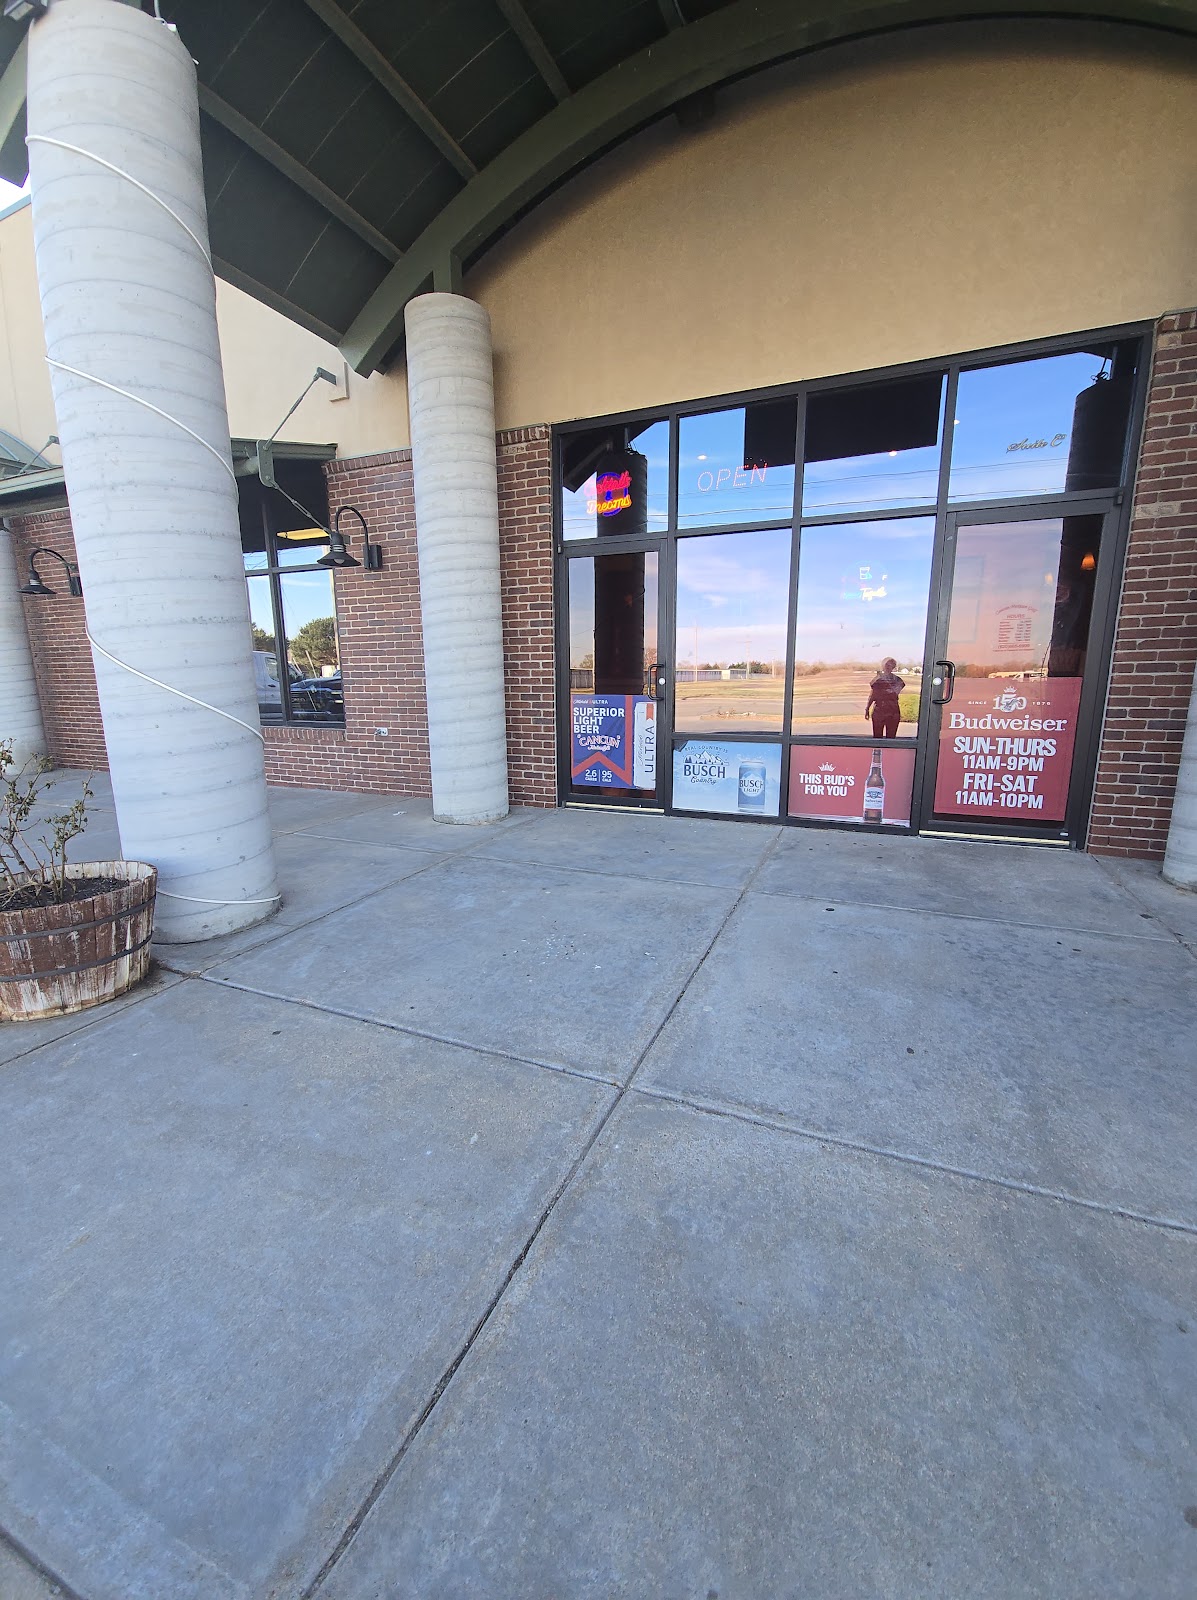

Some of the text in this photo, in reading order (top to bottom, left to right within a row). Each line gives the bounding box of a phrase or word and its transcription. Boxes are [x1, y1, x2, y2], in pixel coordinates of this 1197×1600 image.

[1005, 438, 1048, 454] Suite
[697, 457, 768, 491] OPEN
[586, 495, 633, 515] Dreams
[573, 707, 625, 718] SUPERIOR
[573, 716, 604, 725] LIGHT
[573, 725, 600, 734] BEER
[948, 712, 1068, 731] Budweiser
[644, 725, 655, 773] ULTRA
[953, 736, 1057, 756] SUN-THURS
[683, 764, 726, 779] BUSCH
[962, 754, 1045, 772] 11AM-9PM
[601, 770, 613, 779] 95
[799, 773, 855, 786] THIS BUD'S
[963, 772, 1039, 793] FRI-SAT
[804, 785, 848, 797] FOR YOU
[955, 790, 1044, 809] 11AM-10PM
